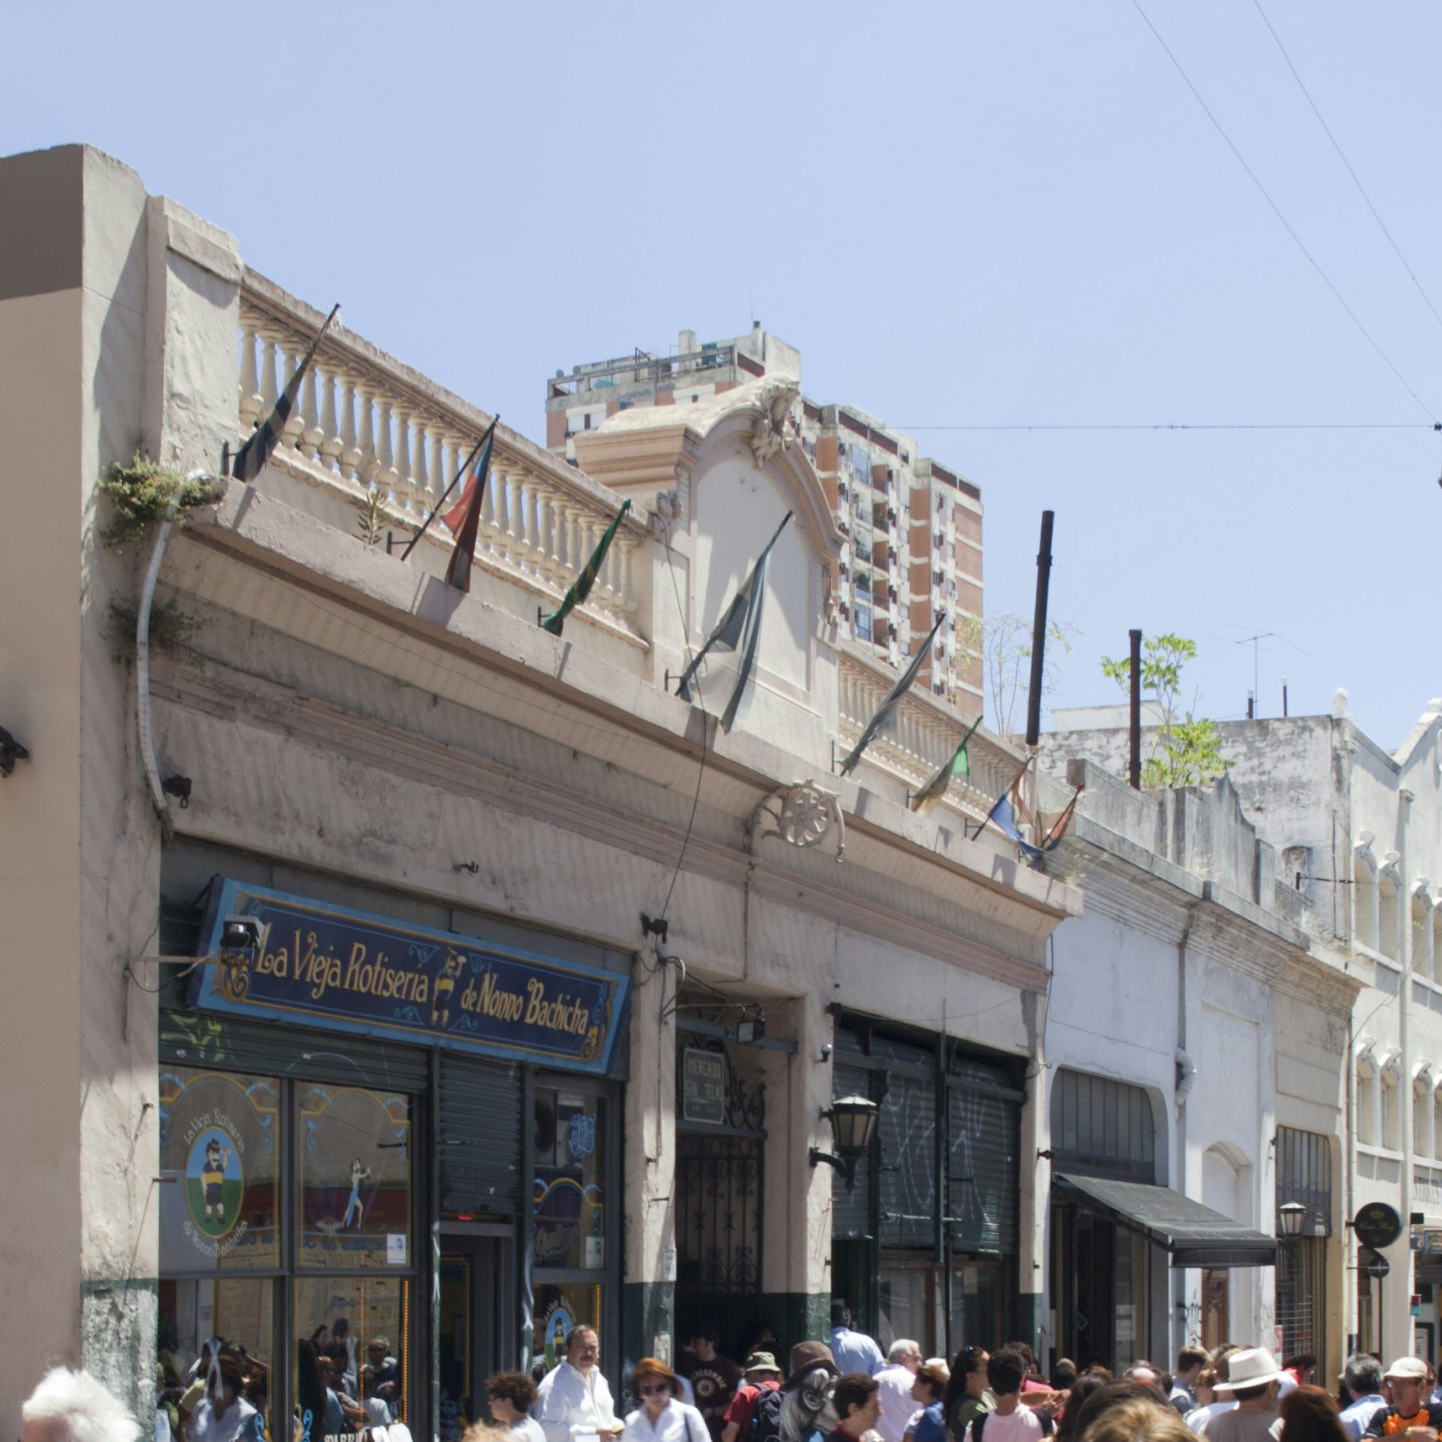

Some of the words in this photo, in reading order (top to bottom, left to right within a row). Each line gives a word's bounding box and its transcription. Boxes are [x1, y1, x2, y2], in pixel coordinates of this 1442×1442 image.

[256, 922, 289, 980] La
[294, 929, 342, 1001] Vieja
[460, 977, 478, 1010] de
[477, 974, 524, 1022] Nonno
[525, 979, 590, 1037] Bachicha
